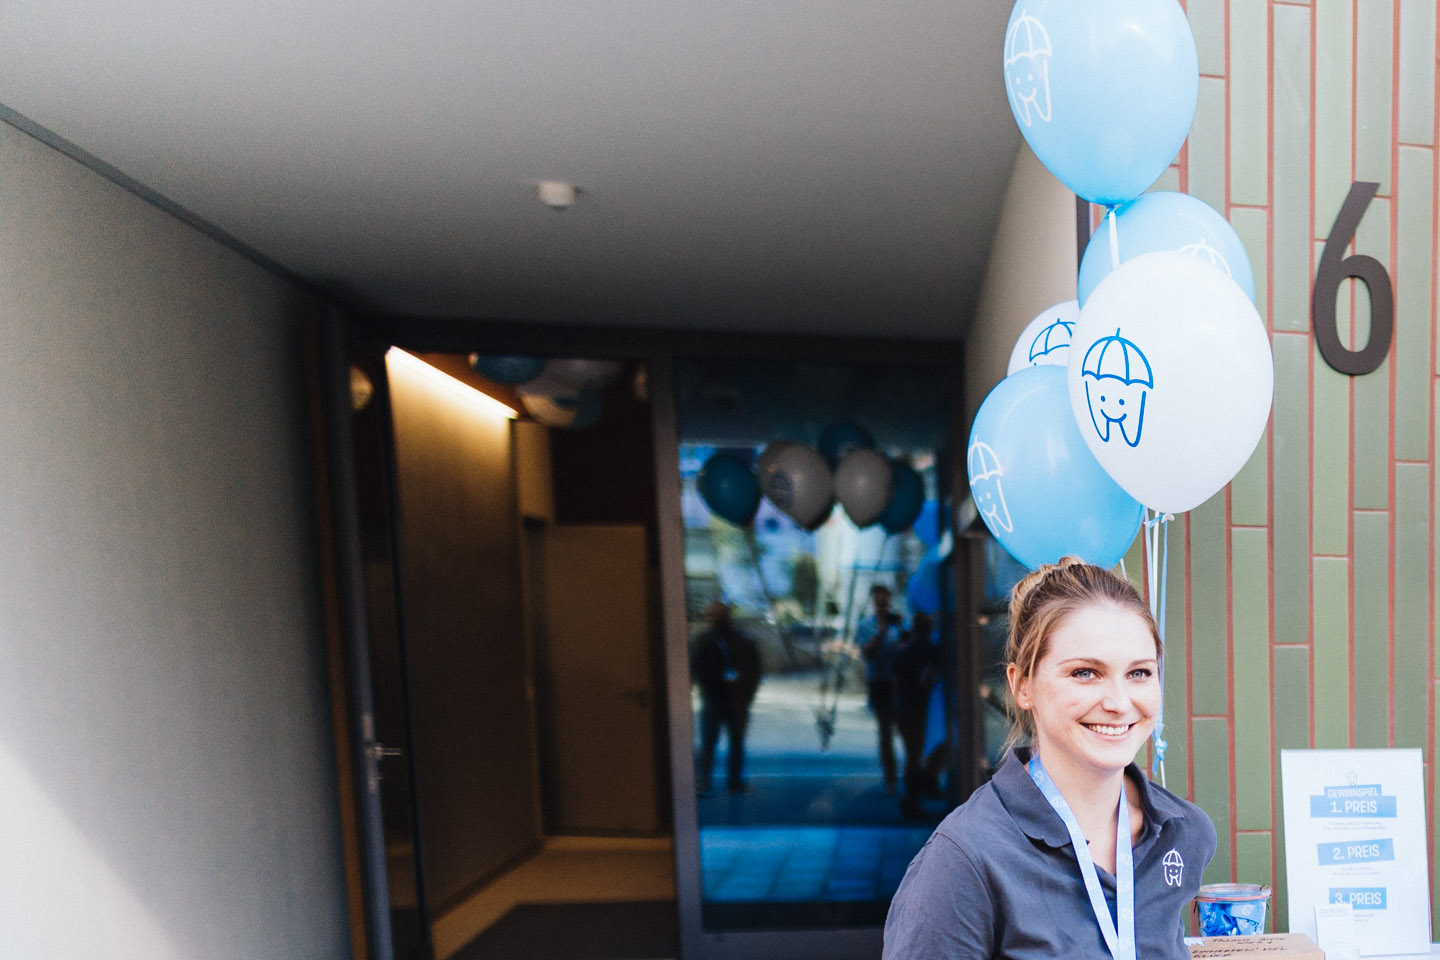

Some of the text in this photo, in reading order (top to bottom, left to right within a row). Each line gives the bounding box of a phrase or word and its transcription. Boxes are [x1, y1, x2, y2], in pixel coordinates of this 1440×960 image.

[1313, 180, 1394, 377] 6
[1327, 787, 1378, 798] GEWINNSPIEL
[1330, 800, 1378, 814] 1. PREIS
[1332, 844, 1380, 860] 2. PREIS
[1335, 891, 1382, 905] 3. PREIS
